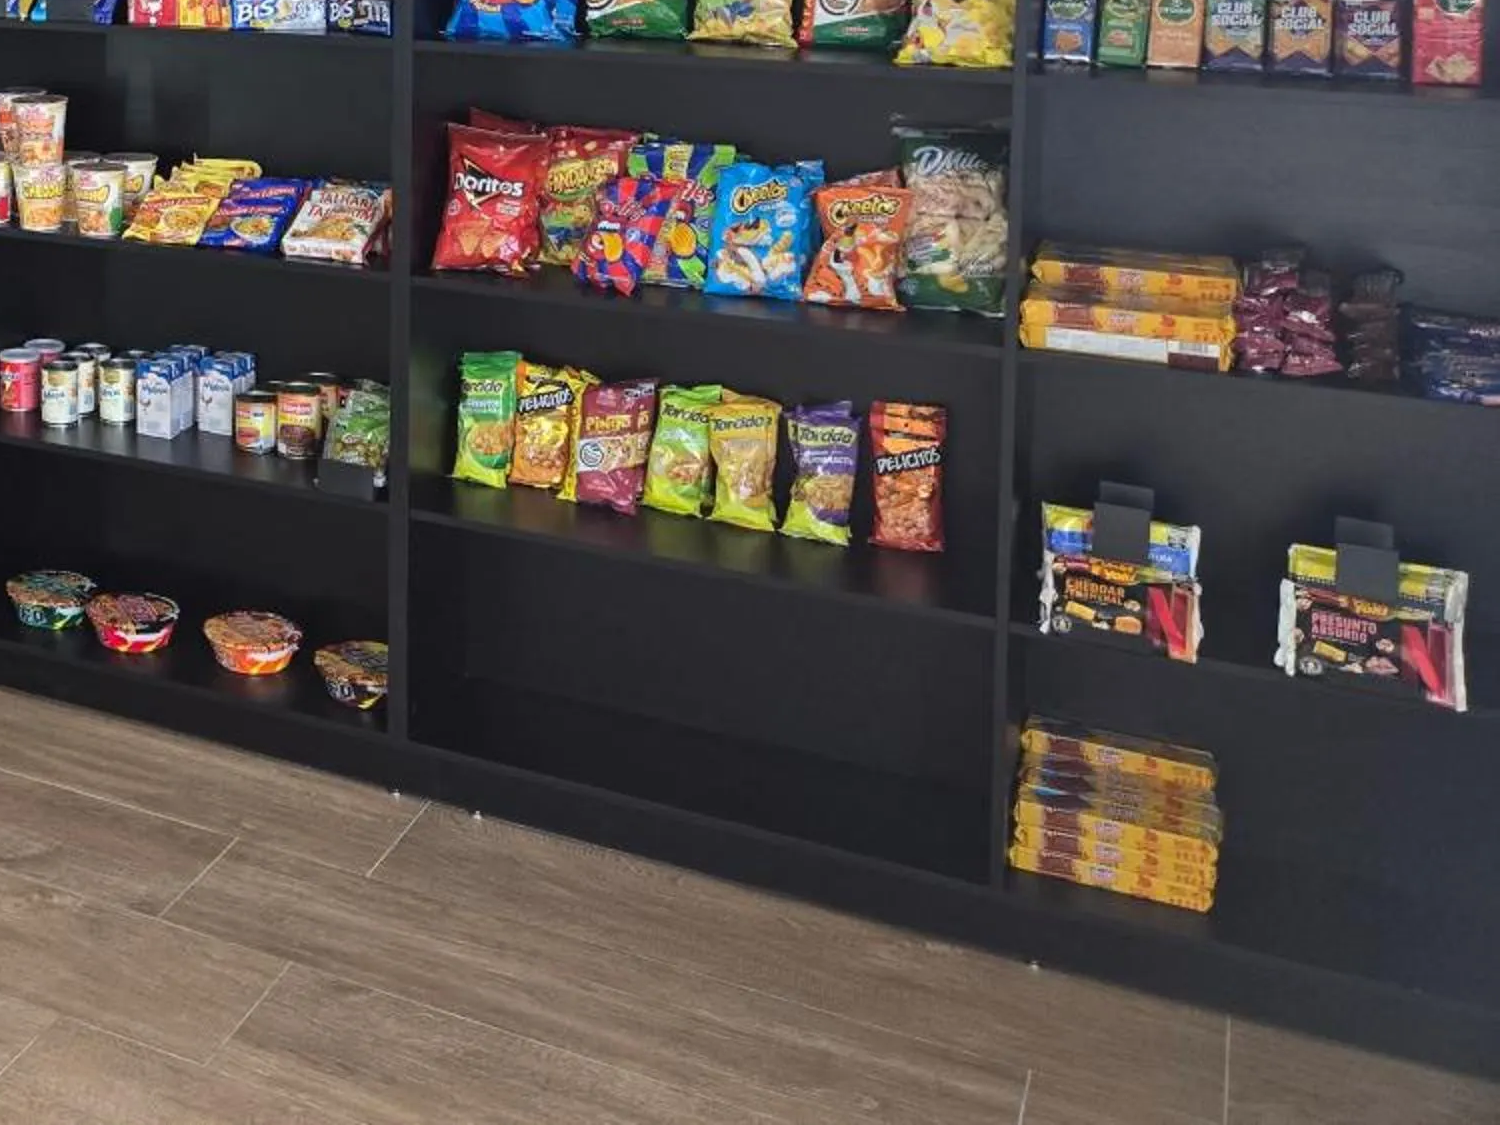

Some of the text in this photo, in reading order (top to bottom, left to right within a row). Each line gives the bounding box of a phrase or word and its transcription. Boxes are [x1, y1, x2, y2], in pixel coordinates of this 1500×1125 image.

[1218, 1, 1252, 15] CLUB
[1281, 5, 1316, 19] CLUB
[1353, 10, 1390, 24] CLUB
[454, 172, 525, 197] Doritos
[462, 379, 503, 392] orcida
[1311, 610, 1377, 635] PRESUNTO
[1311, 624, 1368, 644] ABSURDO
